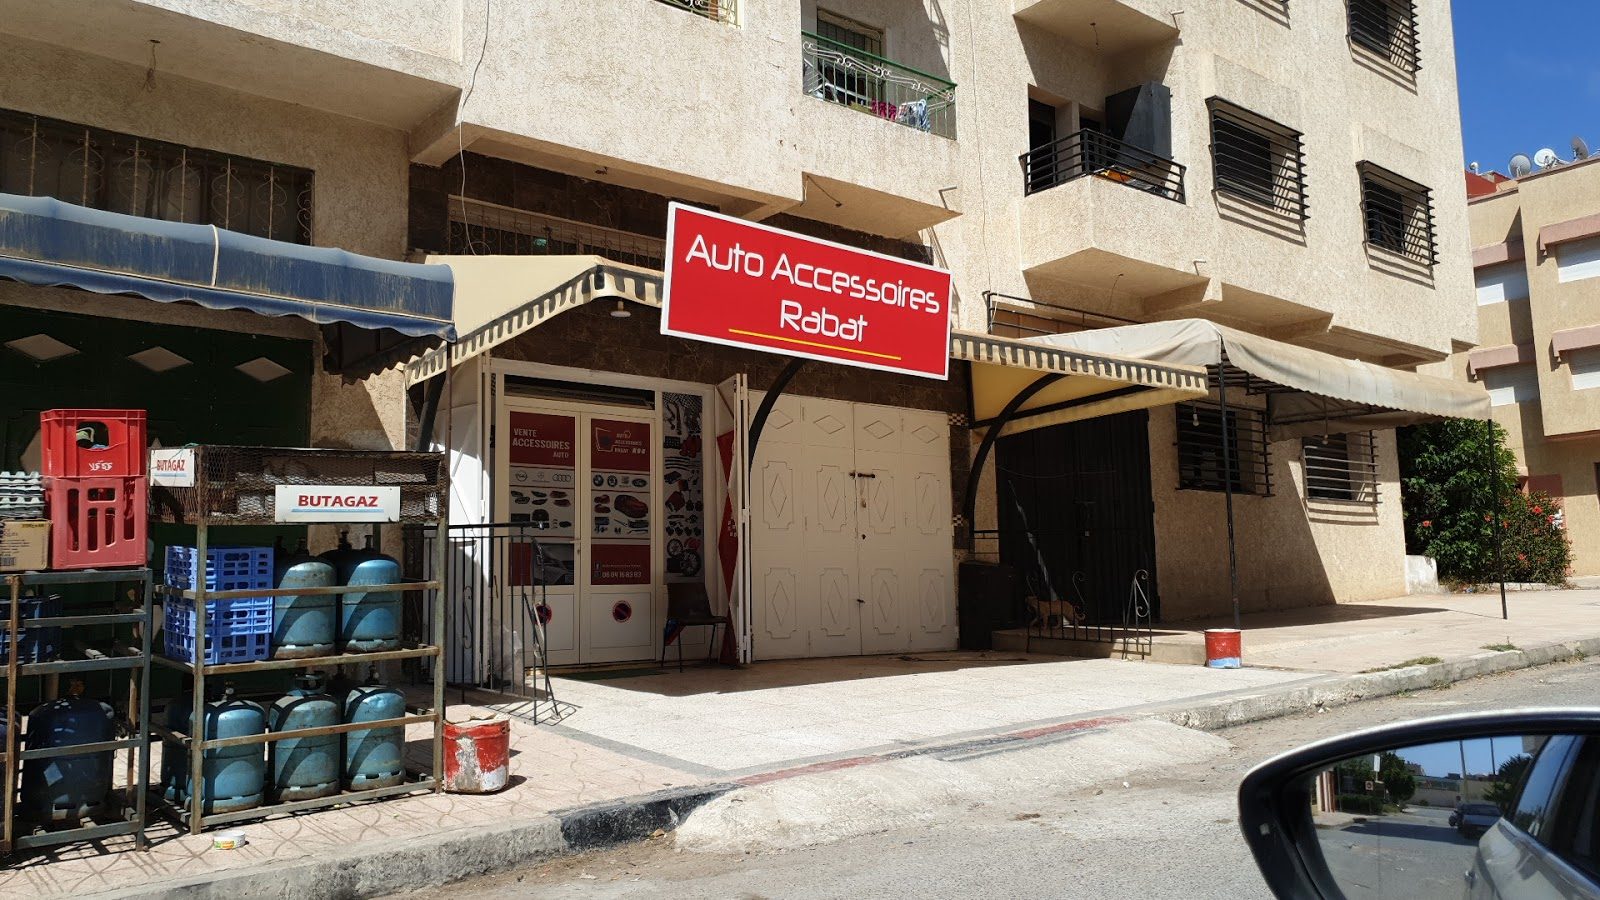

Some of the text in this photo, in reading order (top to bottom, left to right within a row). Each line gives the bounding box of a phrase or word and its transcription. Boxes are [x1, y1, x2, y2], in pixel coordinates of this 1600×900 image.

[685, 234, 940, 314] Auto Accessoires
[779, 299, 868, 342] Rabat
[513, 428, 537, 437] VENTE
[512, 437, 570, 450] ACCESSOIRES
[156, 459, 185, 471] BUTAGAZ
[298, 495, 379, 508] BUTAGAZ
